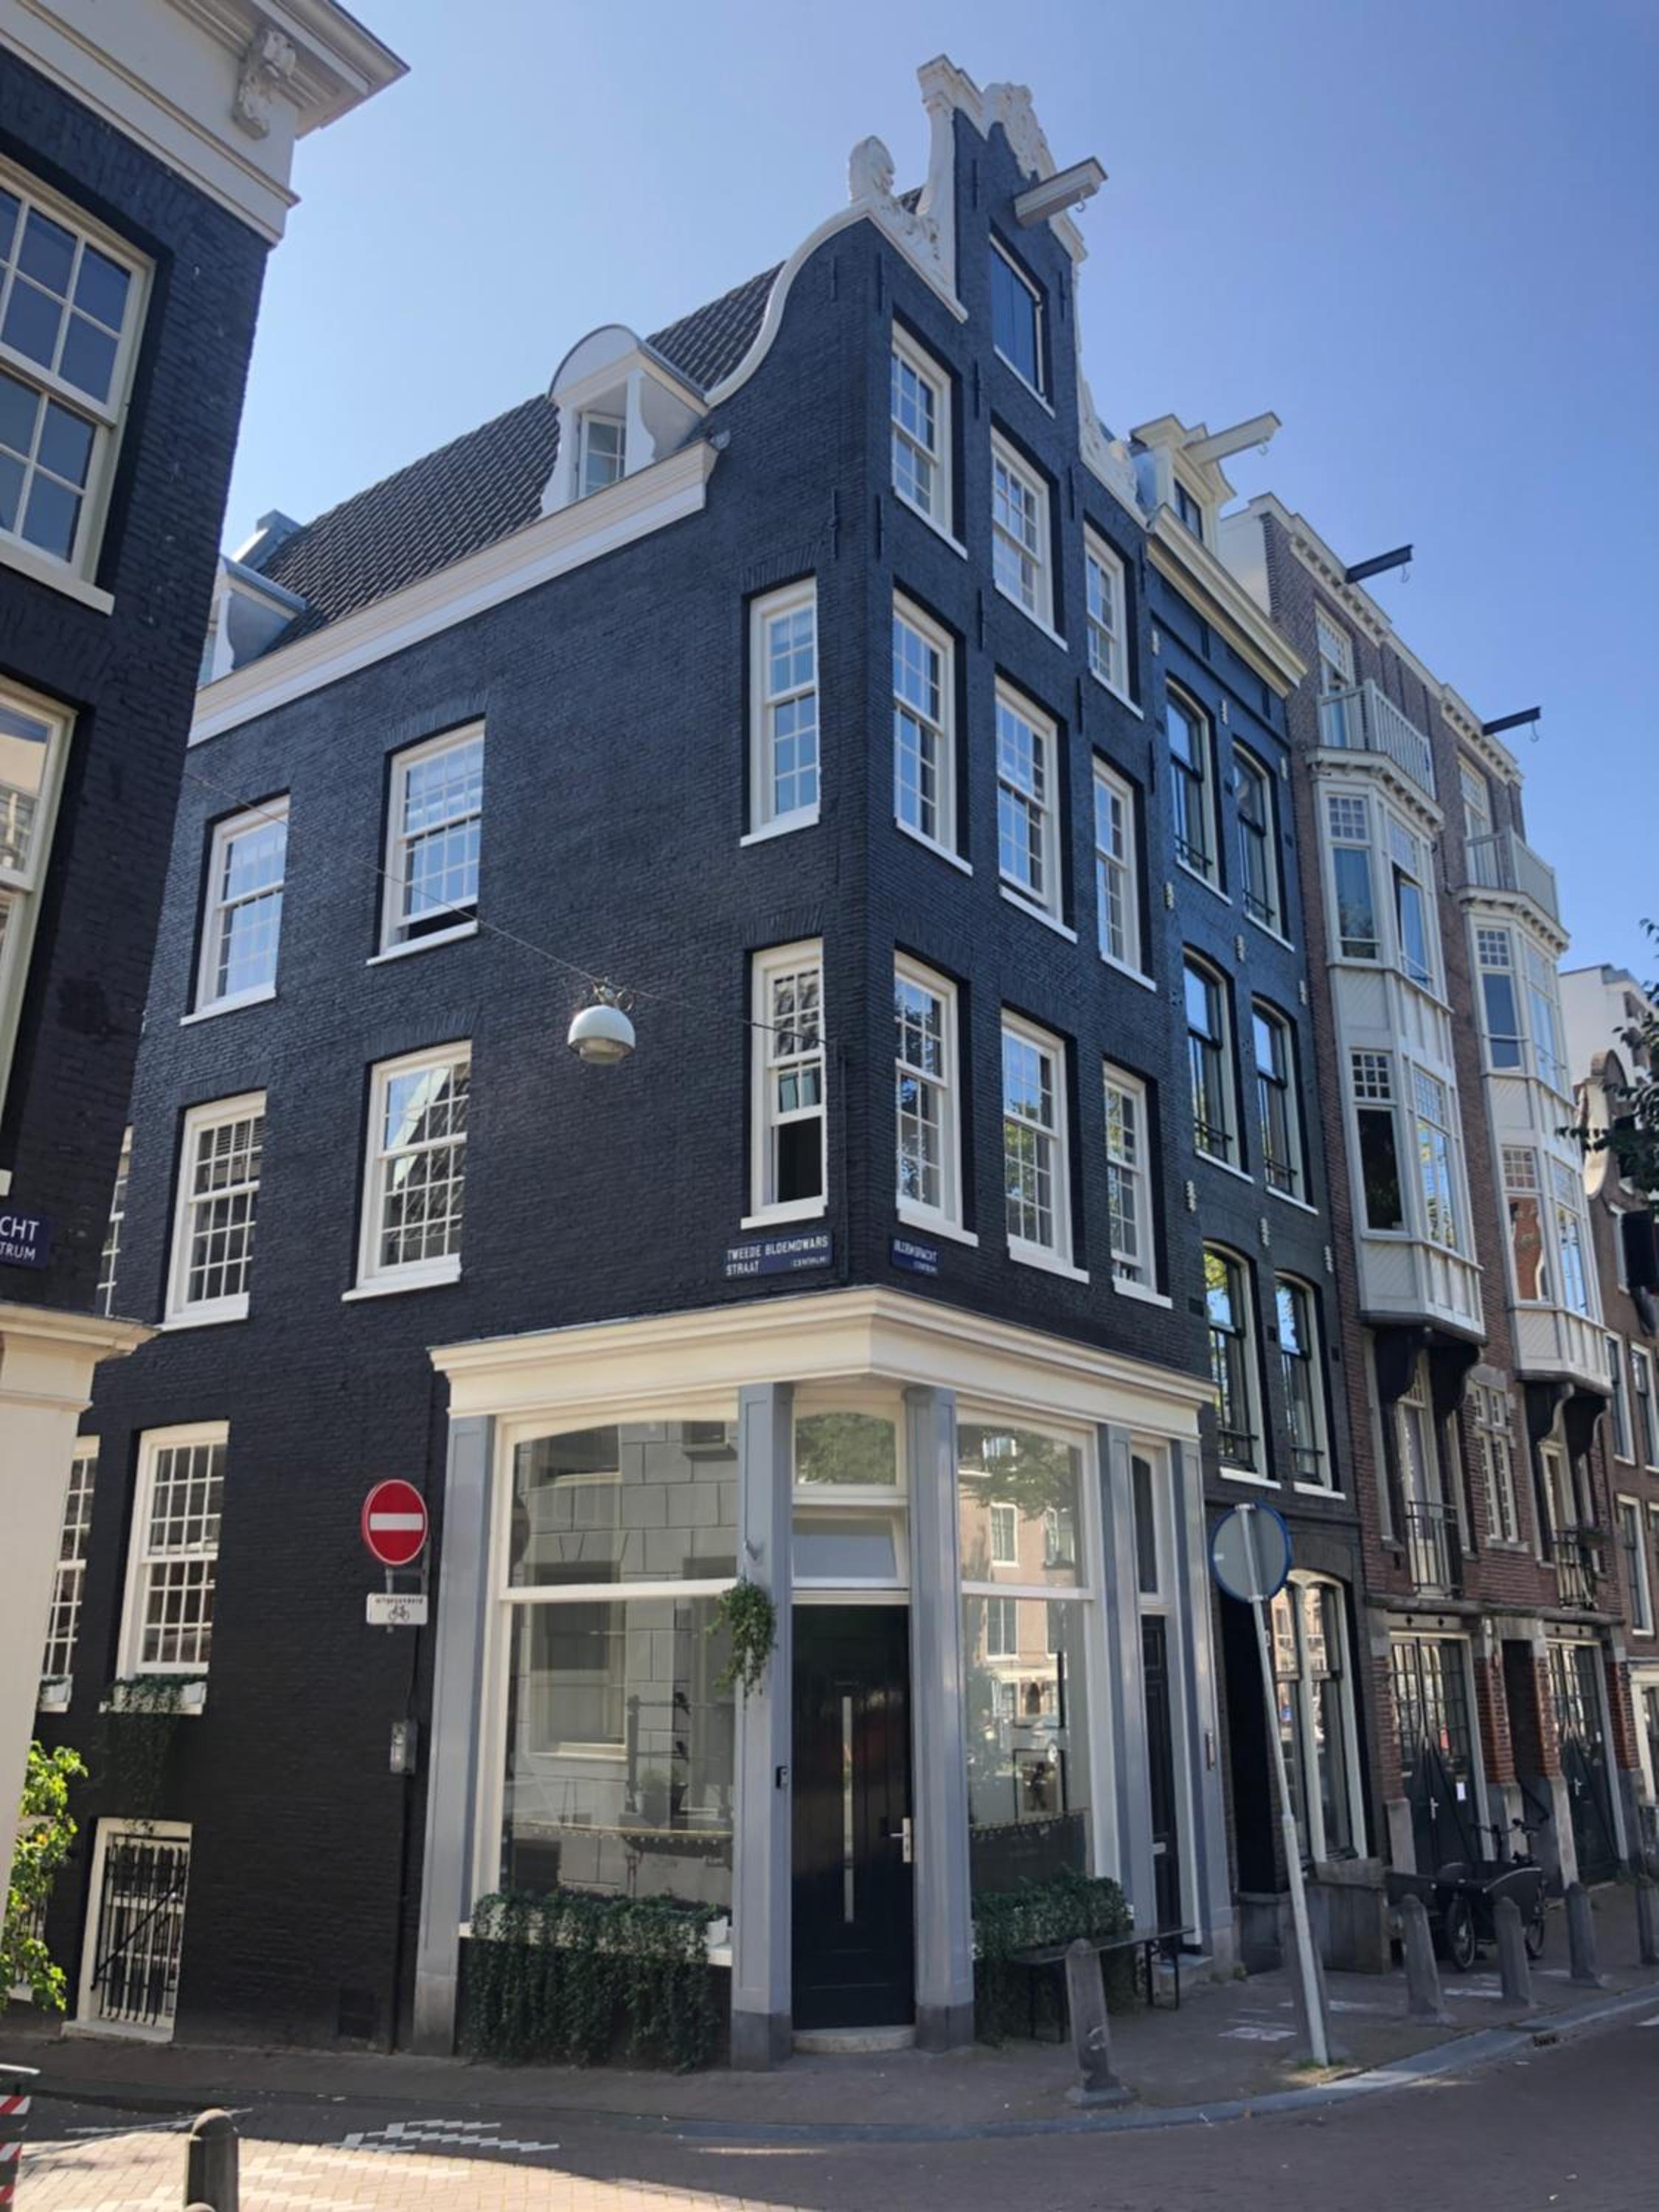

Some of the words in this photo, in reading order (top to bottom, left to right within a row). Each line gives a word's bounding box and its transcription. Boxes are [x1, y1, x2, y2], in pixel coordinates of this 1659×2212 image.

[727, 1244, 762, 1261] TWEEDE
[765, 1235, 828, 1256] BLOEMDWARS
[726, 1260, 759, 1277] STRAAT
